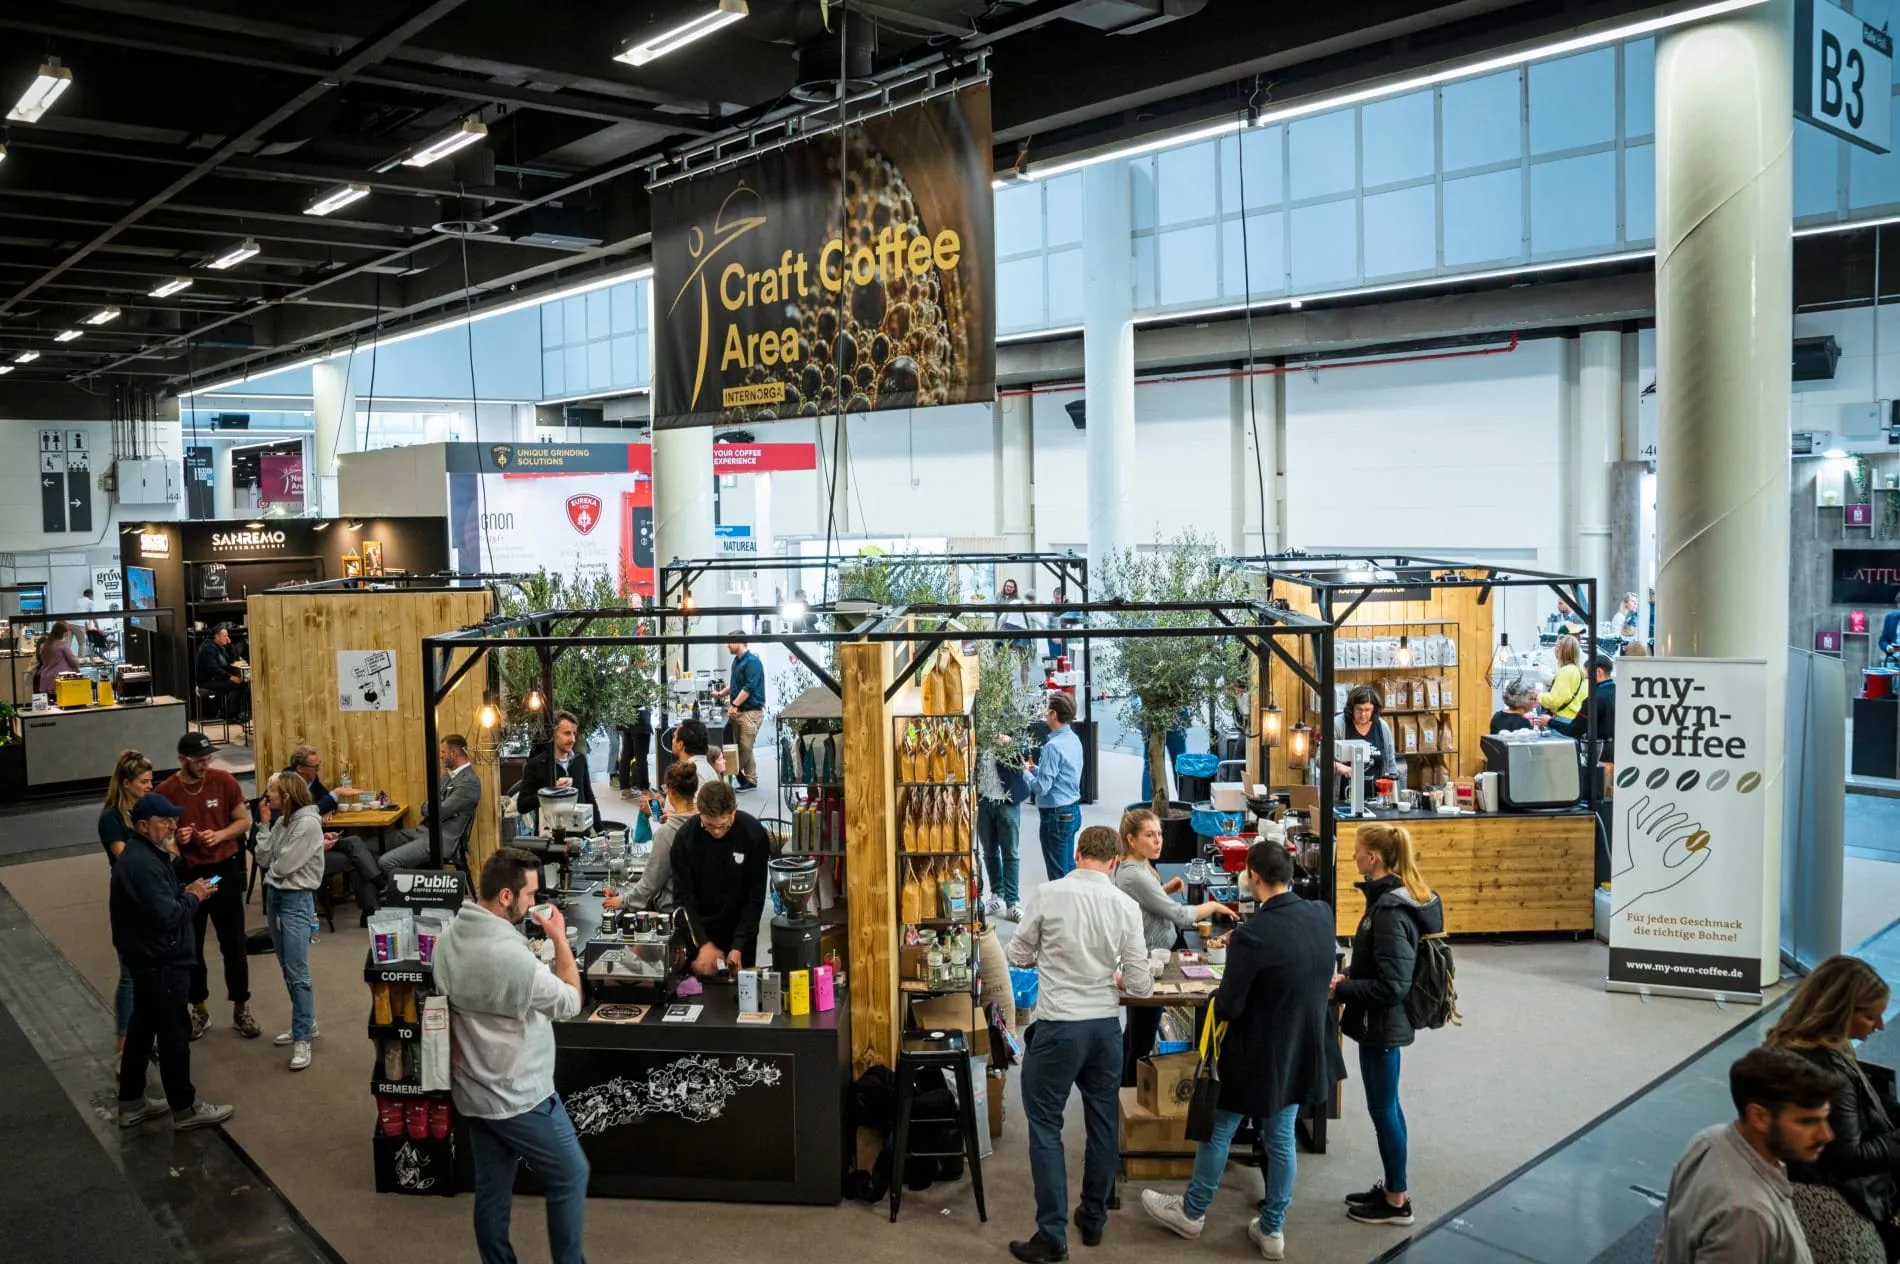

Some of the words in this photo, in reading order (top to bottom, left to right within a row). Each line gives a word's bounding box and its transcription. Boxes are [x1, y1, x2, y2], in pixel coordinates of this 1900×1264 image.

[1821, 29, 1864, 129] B3
[720, 248, 808, 311] Craft
[820, 222, 961, 293] Coffee
[721, 323, 800, 371] Area
[725, 385, 784, 402] INTERNORGA
[517, 449, 549, 457] UNIQUE
[550, 449, 590, 457] GRINDING
[517, 457, 564, 465] SOLUTIONS
[713, 449, 733, 457] YOUR
[734, 449, 762, 457] COFFEE
[570, 497, 597, 507] EUREKA
[212, 531, 286, 546] SANREMO
[1631, 676, 1705, 706] my-
[1632, 703, 1732, 728] own-
[1631, 724, 1746, 759] coffee
[413, 874, 459, 889] Public
[1627, 912, 1645, 922] Für
[1647, 914, 1677, 925] jeden
[1680, 917, 1743, 930] Geschmack
[1634, 926, 1651, 936] die
[1653, 927, 1696, 940] richtige
[1698, 931, 1738, 942] Bohne!
[381, 972, 423, 982] COFFEE
[1626, 961, 1743, 978] www.my-own-coffee.de
[398, 1029, 413, 1039] TO
